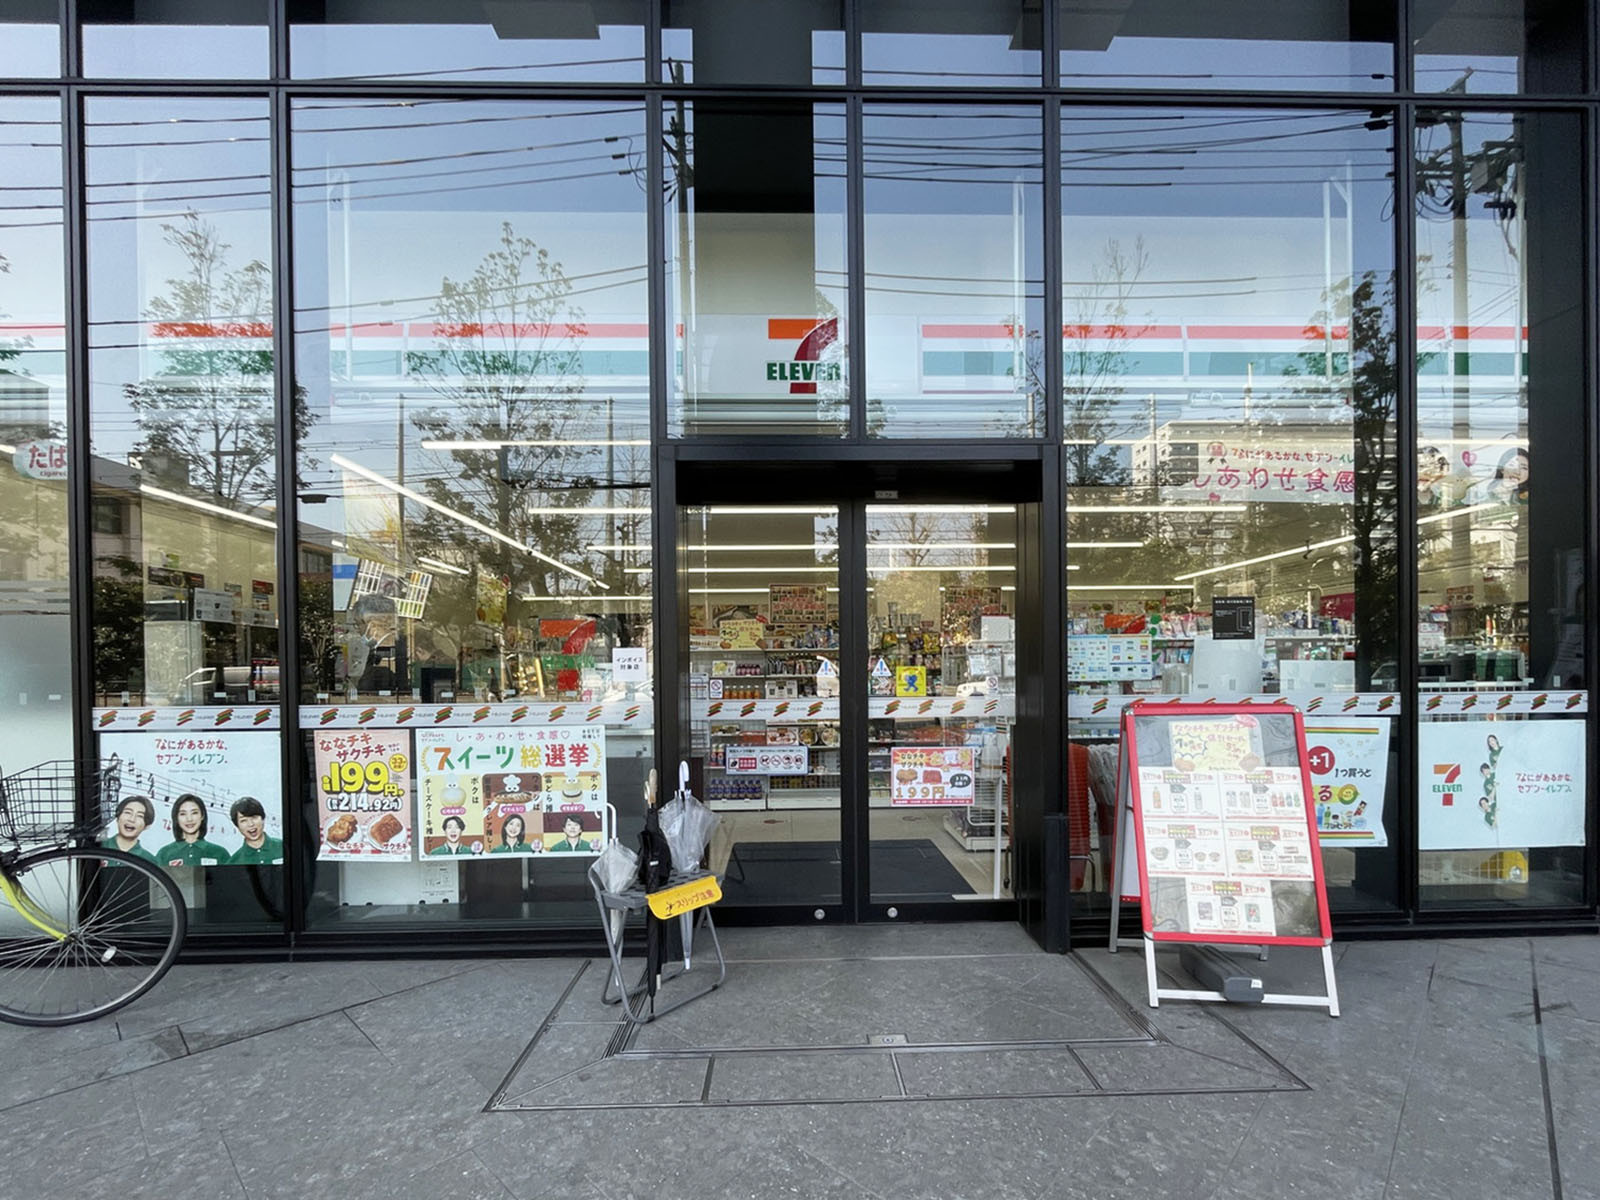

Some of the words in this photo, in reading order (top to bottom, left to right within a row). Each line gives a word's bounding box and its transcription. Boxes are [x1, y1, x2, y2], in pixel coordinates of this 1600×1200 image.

[319, 732, 372, 752] ななチキ
[336, 744, 386, 763] ザクチキ
[1309, 752, 1330, 768] +1
